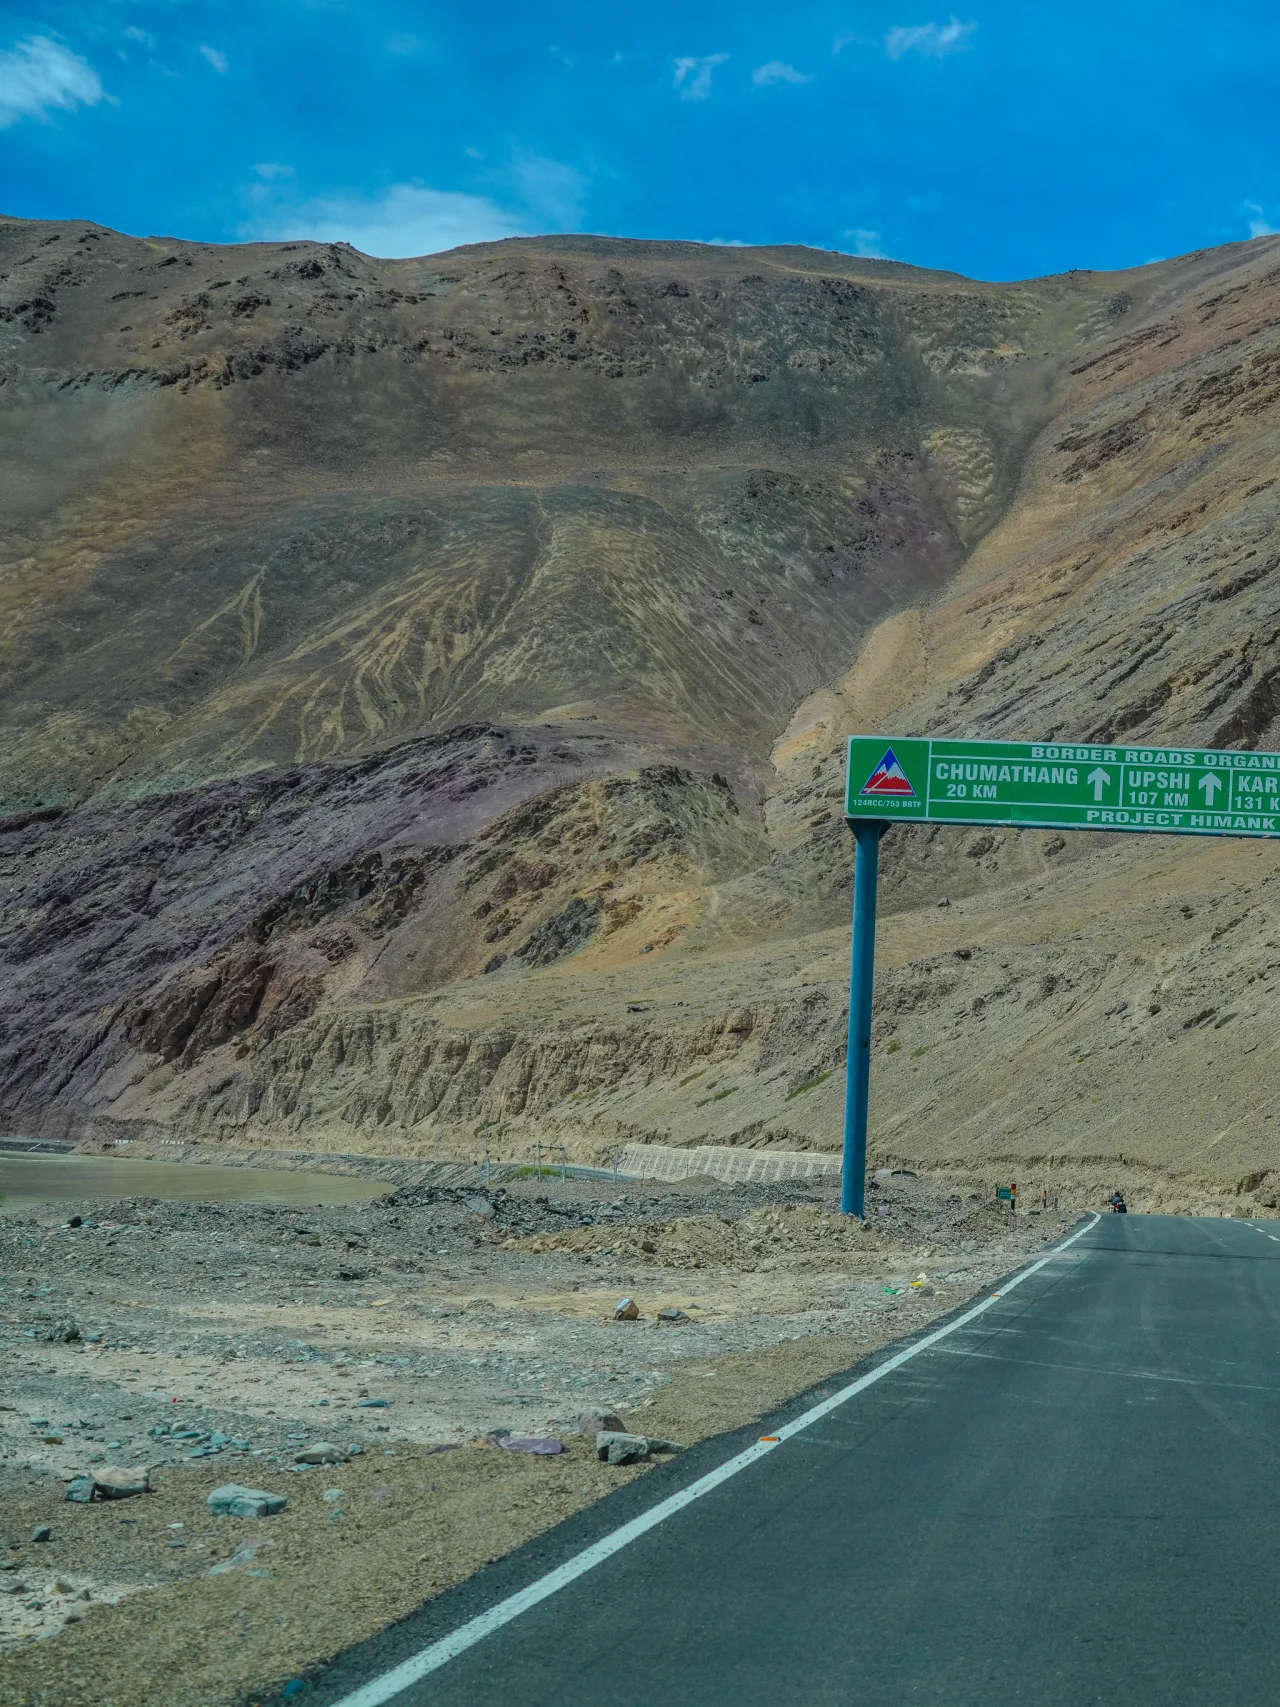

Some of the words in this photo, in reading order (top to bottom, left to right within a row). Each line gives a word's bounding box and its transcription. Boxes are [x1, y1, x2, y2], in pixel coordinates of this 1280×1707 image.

[1031, 747, 1117, 761] BORDER
[1125, 751, 1196, 765] ROADS
[936, 763, 1078, 784] CHUMATHANG
[1129, 771, 1190, 789] UPSHI
[947, 784, 967, 797] 20
[973, 785, 998, 798] KM
[1129, 791, 1158, 805] 107
[1164, 793, 1189, 806] KM
[853, 799, 900, 807] 124RCC/753
[902, 800, 922, 808] BRTF
[1235, 796, 1262, 810] 131
[1087, 810, 1183, 826] PROJECT
[1191, 815, 1276, 829] HIMANK
